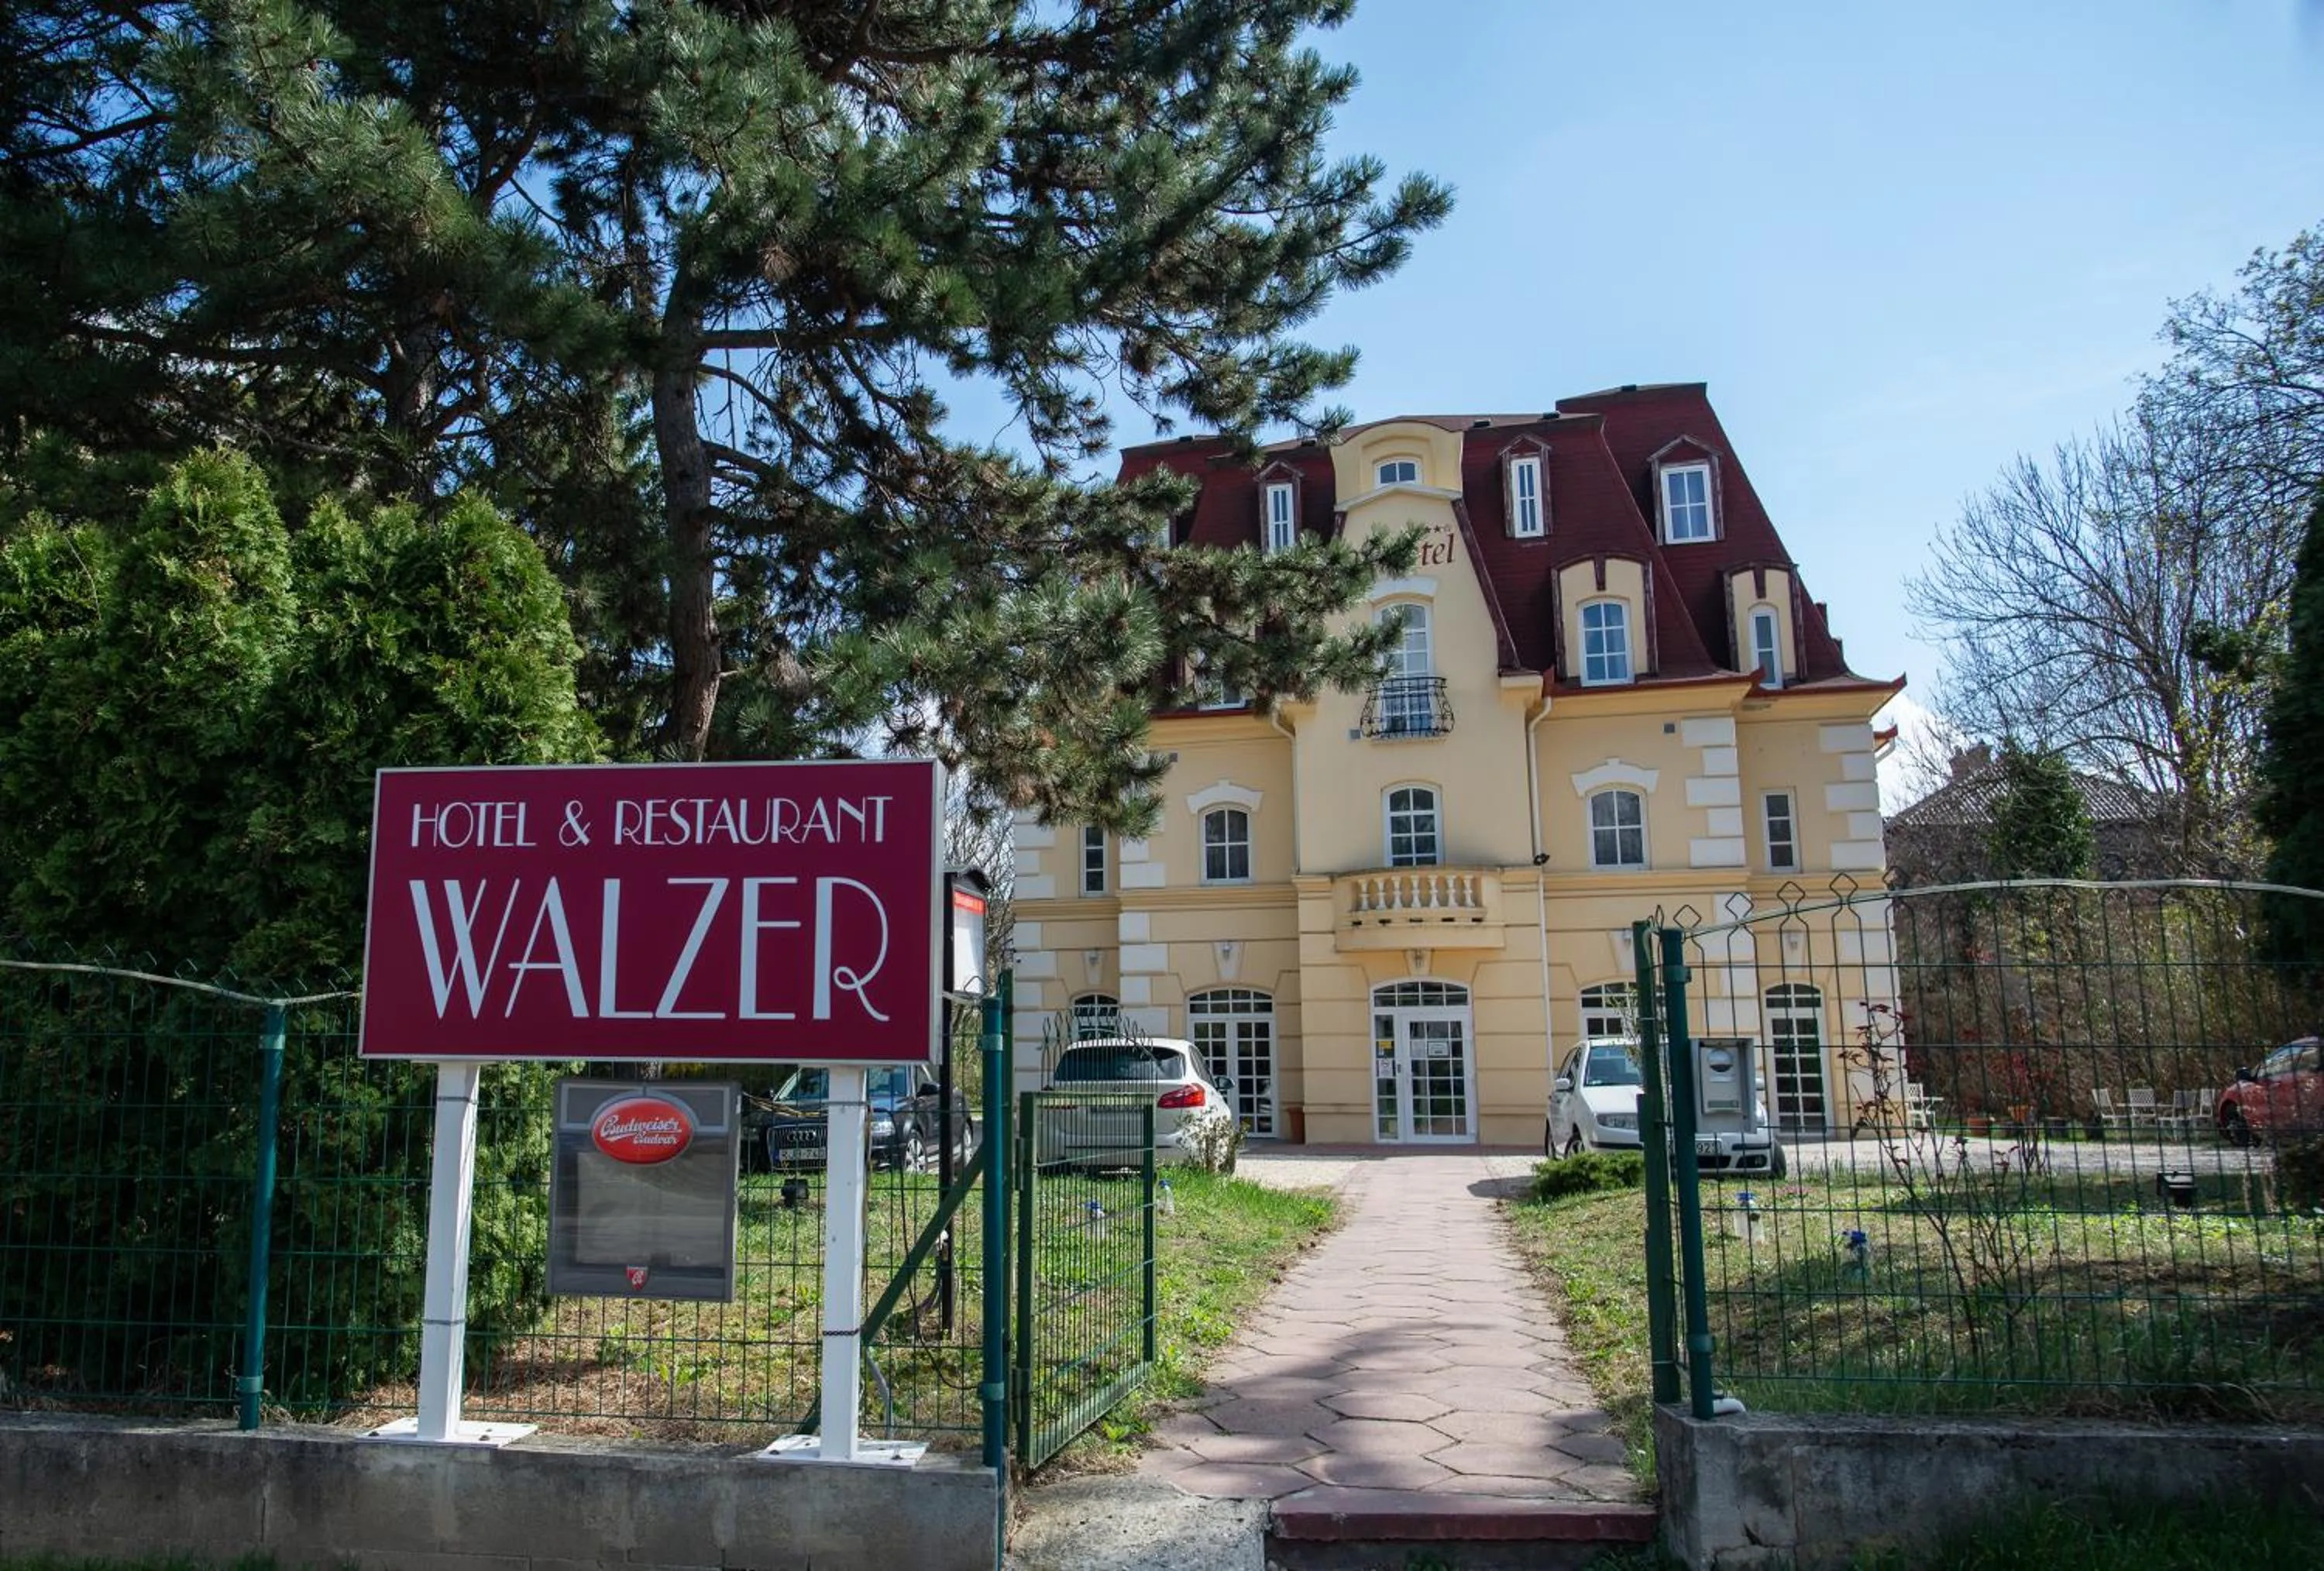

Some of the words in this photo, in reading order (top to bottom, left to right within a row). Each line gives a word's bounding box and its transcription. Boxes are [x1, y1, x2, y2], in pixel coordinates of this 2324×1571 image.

[1422, 533, 1455, 566] tel
[411, 802, 536, 847] HOTEL
[559, 800, 590, 847] &
[614, 796, 893, 845] RESTAURANT
[409, 876, 890, 1021] WALZER
